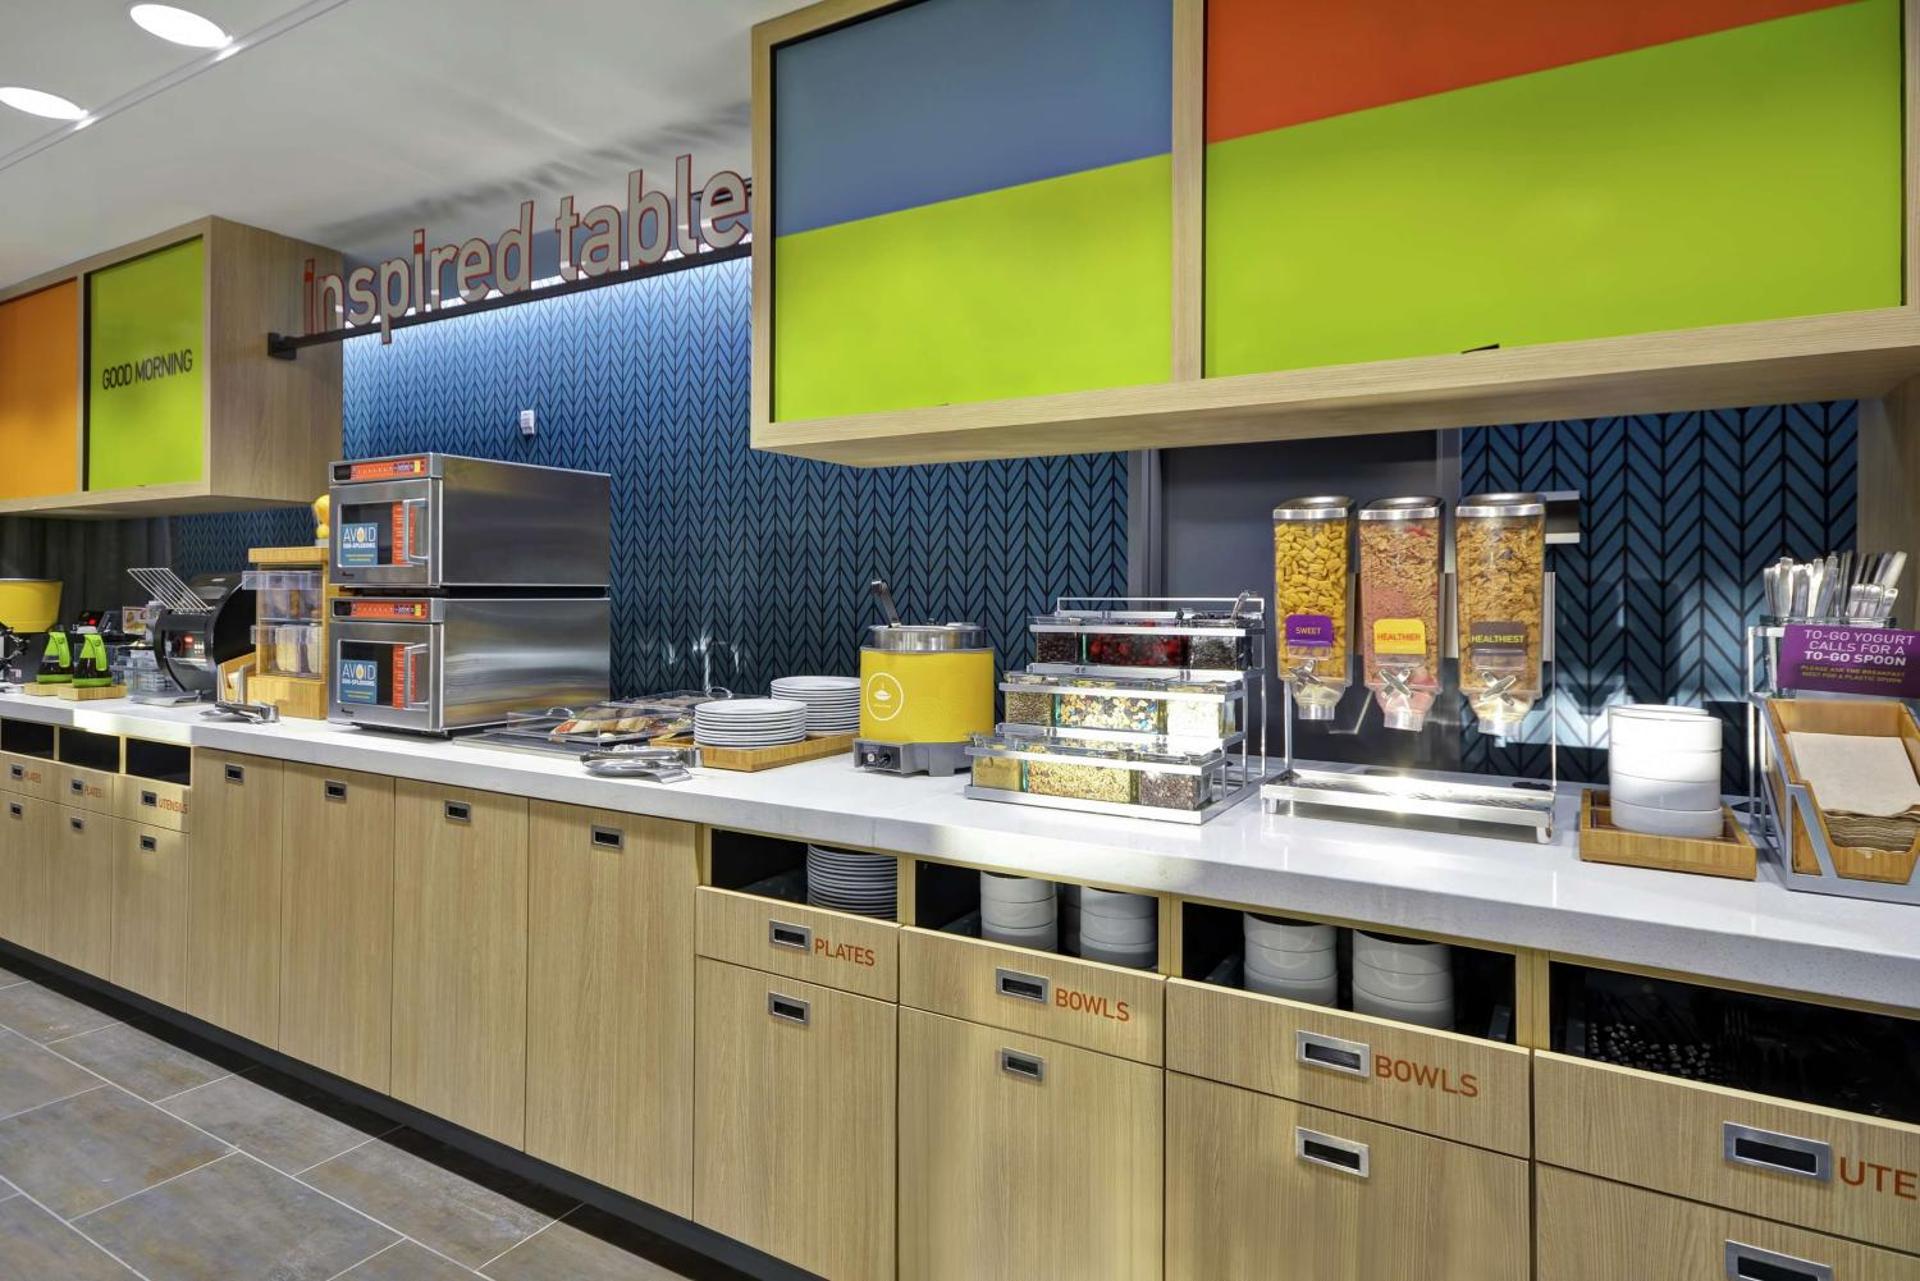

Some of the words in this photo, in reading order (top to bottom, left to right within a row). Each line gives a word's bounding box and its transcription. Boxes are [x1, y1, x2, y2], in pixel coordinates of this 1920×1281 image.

[303, 200, 534, 344] inspired
[555, 154, 750, 283] table
[103, 361, 132, 390] GOOD
[135, 348, 192, 384] MORNING
[343, 526, 376, 543] AVOID
[1295, 626, 1322, 635] SWEET
[1376, 632, 1421, 641] HEALTHIER
[1471, 634, 1524, 643] HEALTHIEST
[1804, 629, 1850, 641] TO-GO
[1854, 632, 1916, 646] YOGURT
[1808, 640, 1857, 653] CALLS
[1860, 643, 1891, 655] FOR
[1894, 645, 1905, 656] A
[1804, 650, 1850, 663] TO-GO
[1854, 654, 1907, 666] SPOON
[342, 663, 377, 680] AVOID
[814, 938, 876, 967] PLATES
[1055, 988, 1131, 1023] BOWLS
[1375, 1054, 1479, 1098] BOWLS
[1840, 1156, 1919, 1201] UTE
